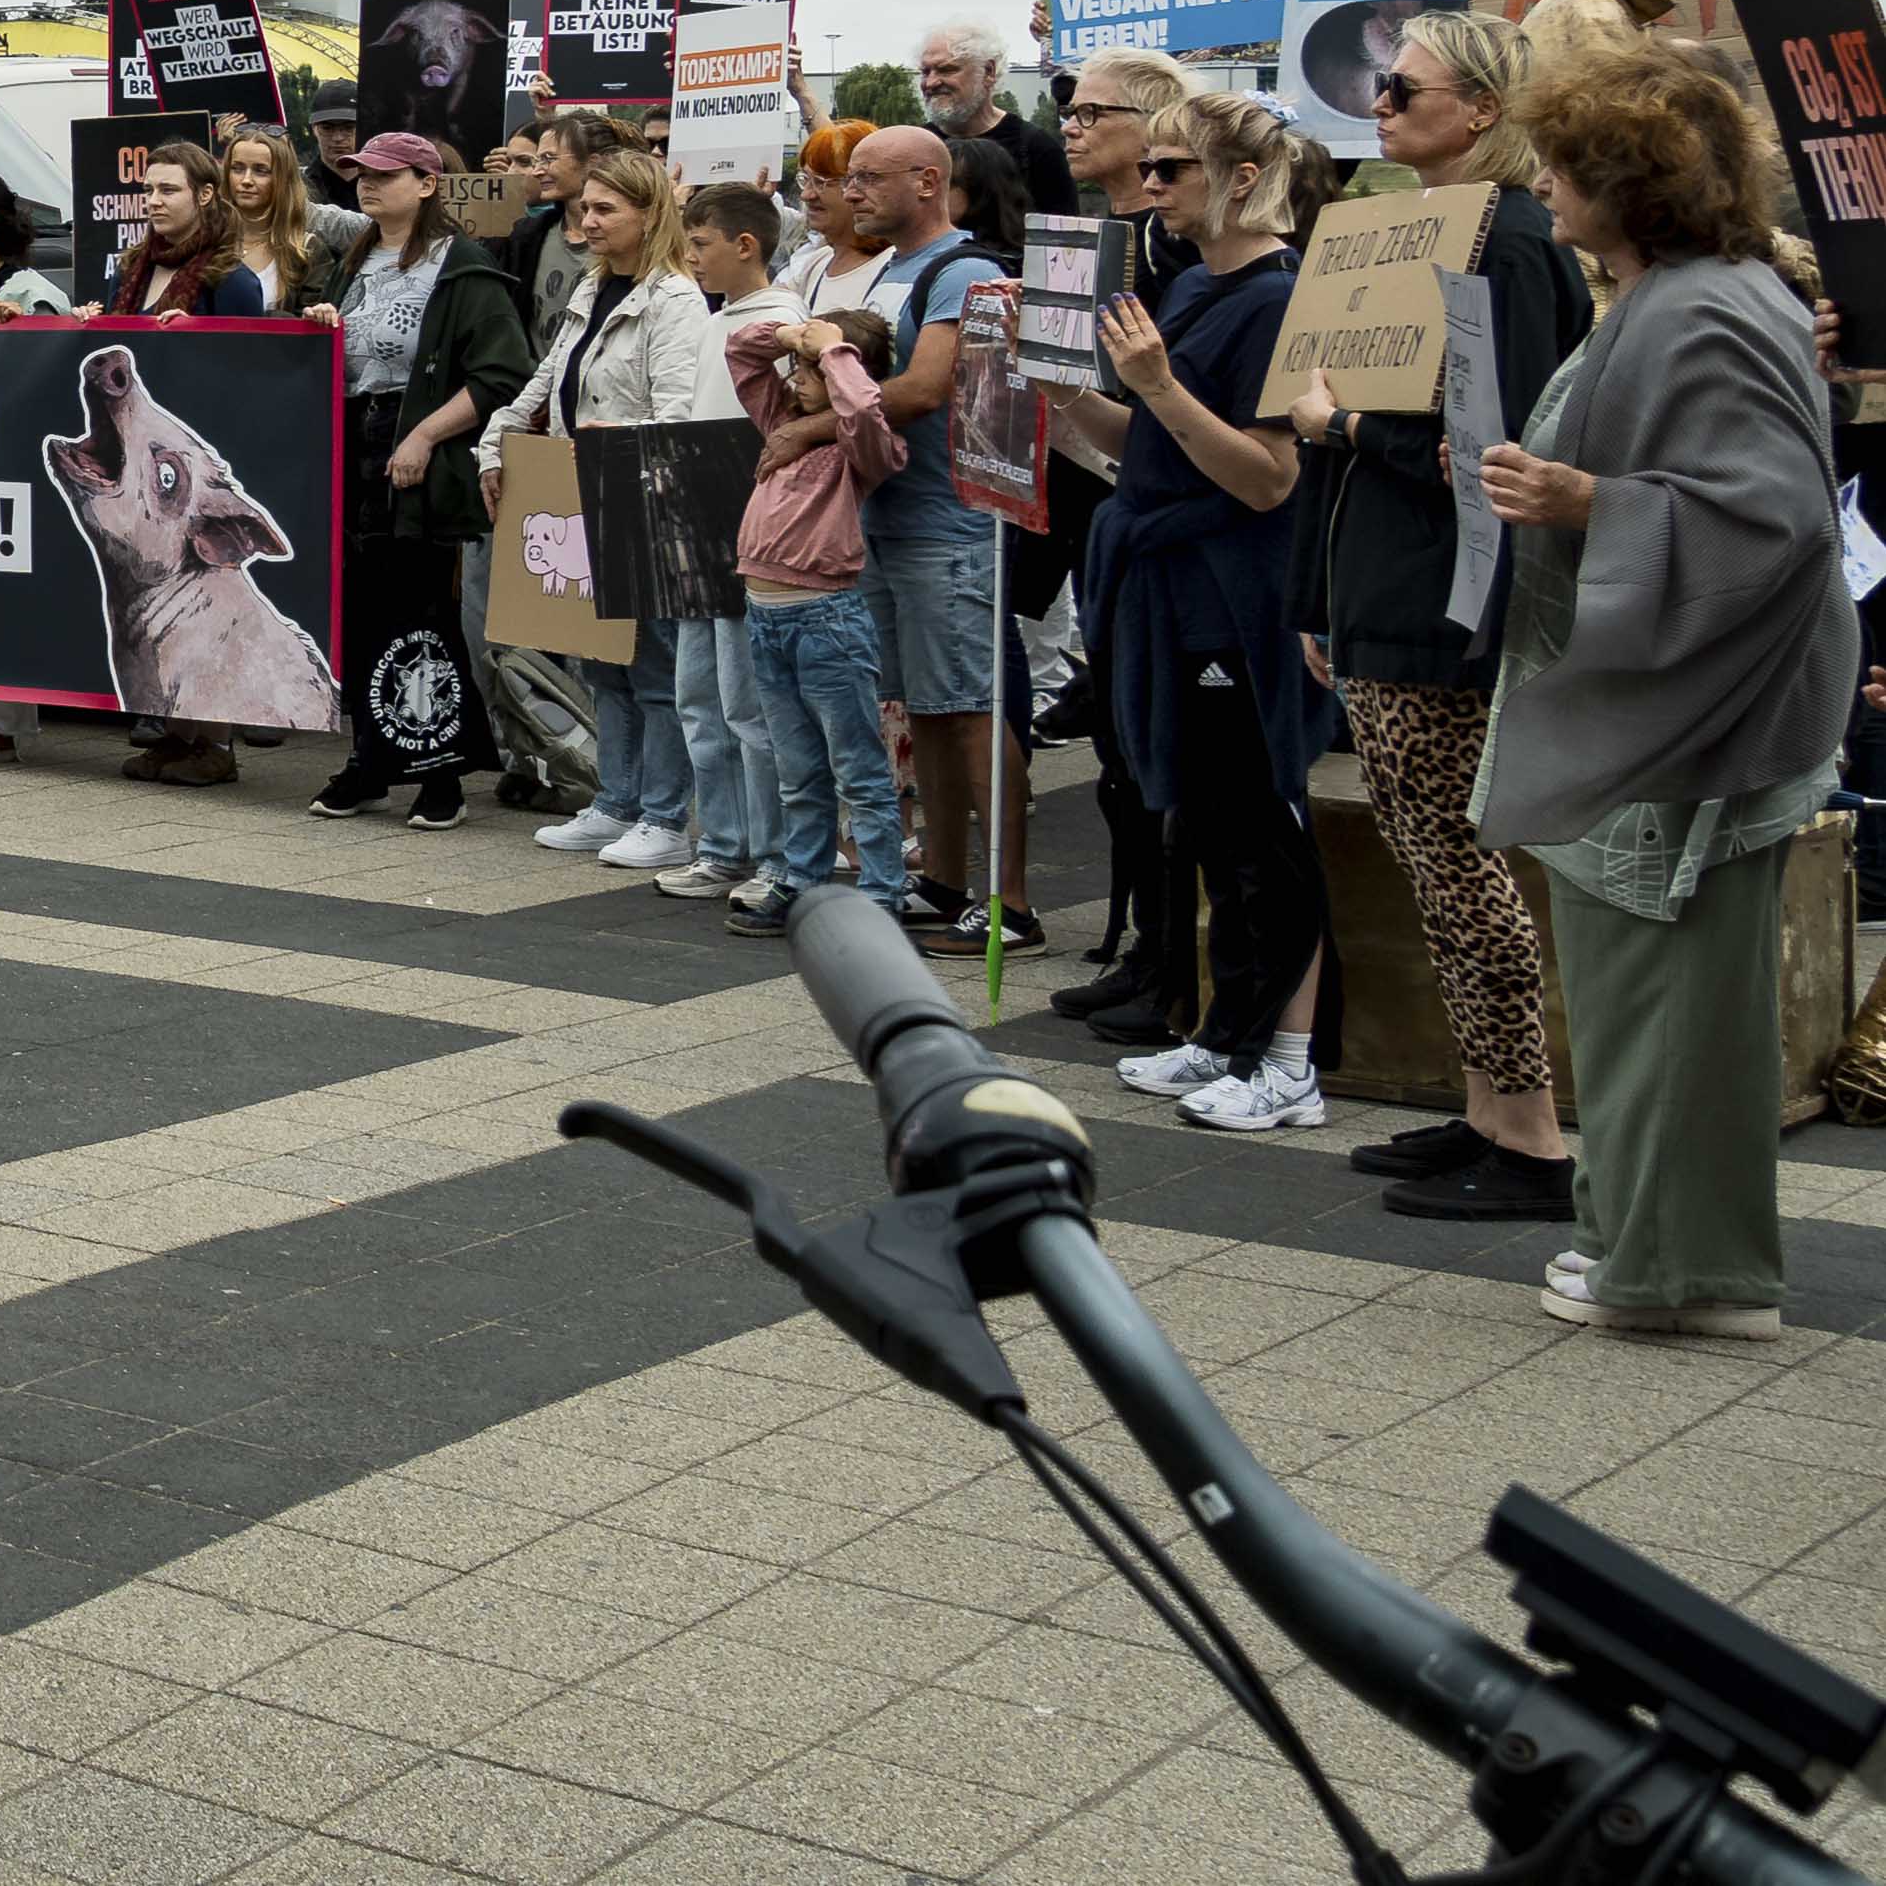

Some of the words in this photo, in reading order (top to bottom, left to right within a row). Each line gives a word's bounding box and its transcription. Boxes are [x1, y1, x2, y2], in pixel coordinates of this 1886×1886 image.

[180, 9, 213, 24] WER
[186, 42, 226, 59] WIRD
[601, 33, 639, 49] IST!
[1060, 18, 1168, 57] LEBEN!
[165, 55, 261, 78] VERKLAGT!
[679, 49, 781, 87] TODESKAMPF
[676, 100, 689, 119] IM
[692, 91, 781, 117] KOHLENDIOXID!
[1375, 215, 1447, 266] ZEIGEN
[1319, 324, 1427, 370] VERBRECHEN
[381, 723, 396, 739] IS
[396, 735, 425, 751] NOT
[429, 737, 440, 750] A
